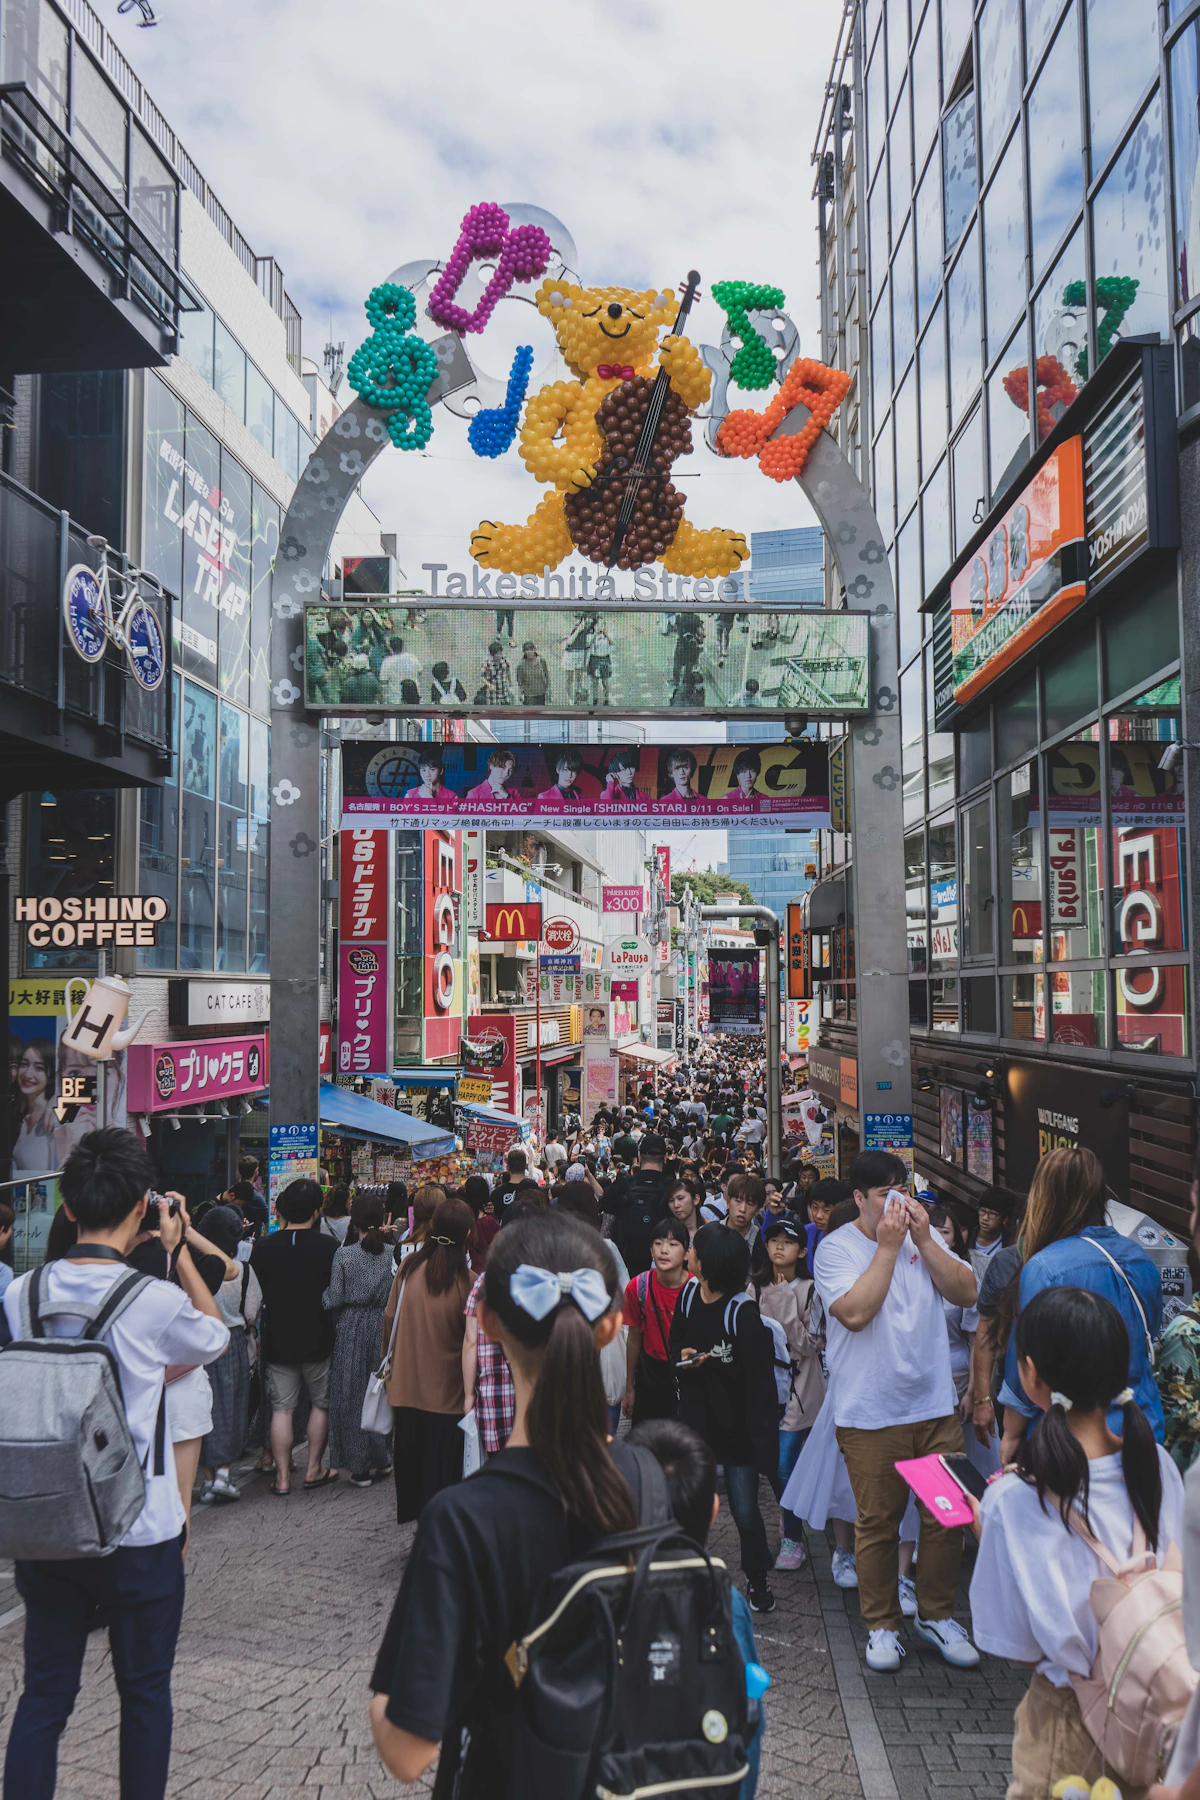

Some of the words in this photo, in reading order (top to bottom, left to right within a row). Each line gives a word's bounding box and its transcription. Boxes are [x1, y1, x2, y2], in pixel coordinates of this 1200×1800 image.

[164, 479, 237, 570] LASER
[344, 559, 355, 569] 3F
[194, 553, 251, 621] TRAP
[422, 563, 618, 601] Takeshita
[634, 567, 757, 604] Street
[131, 639, 147, 682] Hney
[540, 805, 560, 813] New
[563, 804, 591, 813] Single
[690, 804, 711, 813] 9/11
[717, 805, 729, 813] On
[732, 803, 754, 812] Sale!
[16, 896, 169, 922] HOSHINO
[606, 897, 639, 911] ¥300
[433, 829, 456, 1009] EGO
[28, 922, 156, 947] COFFEE
[547, 930, 573, 942] 消火栓
[611, 951, 620, 963] La
[622, 952, 649, 964] Pausa
[207, 994, 226, 1010] CAT
[228, 994, 252, 1010] CAFE
[71, 1005, 114, 1049] H
[797, 1001, 812, 1051] プリクラ
[62, 1077, 86, 1097] BF
[460, 1081, 491, 1092] ハッピーワン
[458, 1092, 477, 1101] HAPPY
[477, 1093, 491, 1103] ONE
[1037, 1108, 1079, 1134] WOLFGANG
[467, 1141, 511, 1151] SQUEEZ
[468, 1131, 516, 1146] スクイーズ
